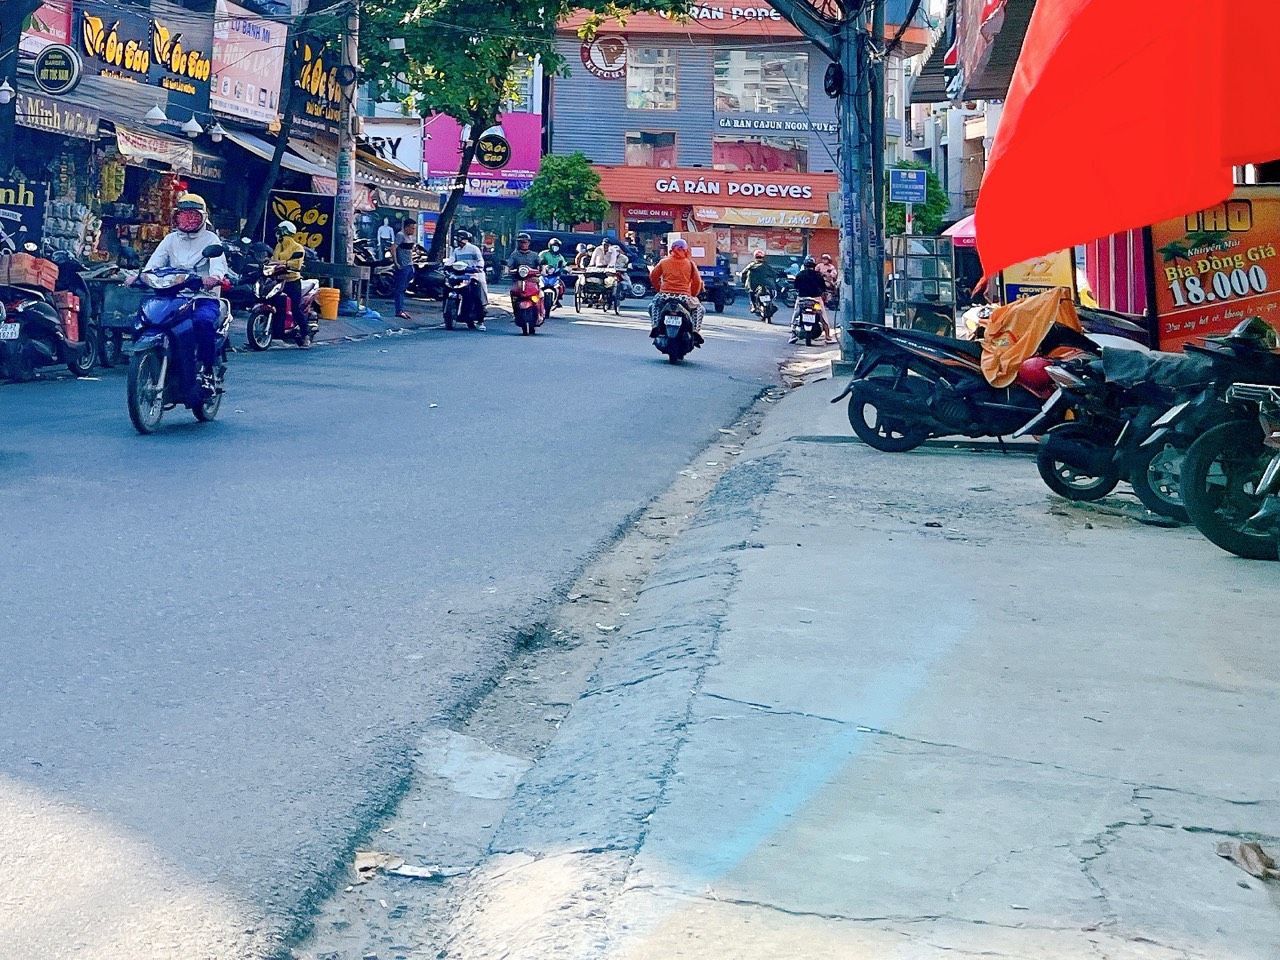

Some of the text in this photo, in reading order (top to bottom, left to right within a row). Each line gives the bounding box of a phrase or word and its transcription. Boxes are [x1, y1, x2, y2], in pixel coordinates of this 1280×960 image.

[27, 97, 61, 129] Minh
[719, 116, 731, 127] GÀ
[733, 116, 751, 128] RÁN
[754, 120, 782, 130] CAJUN
[785, 121, 808, 131] NGON
[655, 176, 682, 194] GÀ
[684, 177, 719, 195] RÁN
[628, 208, 648, 216] COME
[293, 227, 324, 248] áo
[1164, 242, 1277, 281] Bia Đồng Giá
[1168, 264, 1267, 307] 18.000
